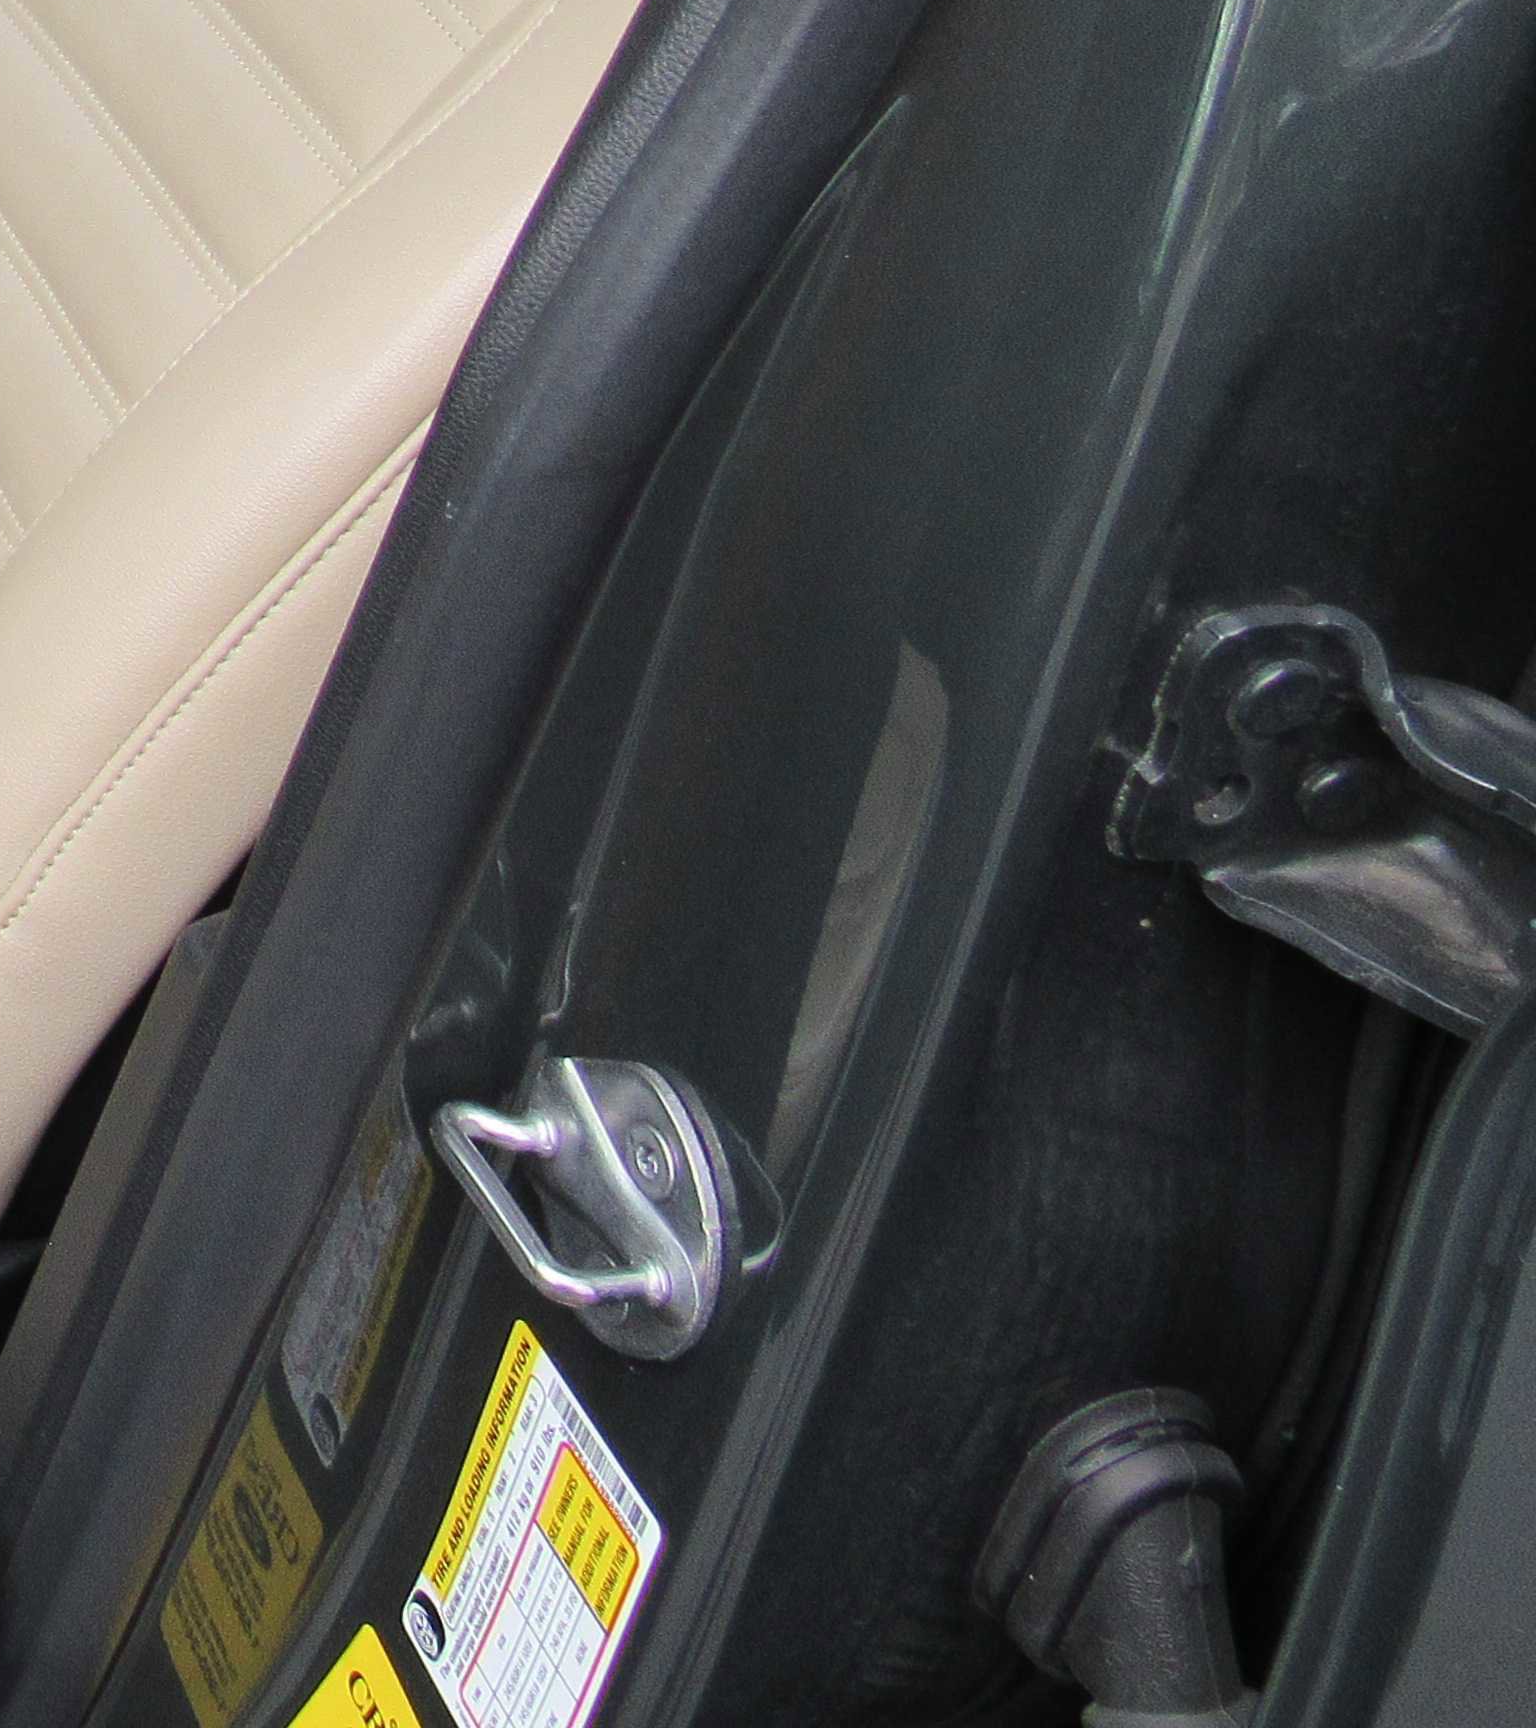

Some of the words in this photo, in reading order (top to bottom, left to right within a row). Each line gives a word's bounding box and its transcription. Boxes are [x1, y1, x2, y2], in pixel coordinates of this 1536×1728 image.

[430, 1548, 451, 1590] TIRE
[446, 1515, 465, 1553] AND
[459, 1449, 491, 1516] LOADING
[486, 1342, 530, 1443] INFORMATION
[505, 1509, 521, 1539] 412
[529, 1444, 545, 1475] 910
[546, 1517, 560, 1543] SEE
[562, 1521, 584, 1567] MANUAL
[579, 1496, 594, 1524] FOR
[578, 1524, 608, 1588] ADDITIONAL
[594, 1544, 626, 1614] INFORMATION
